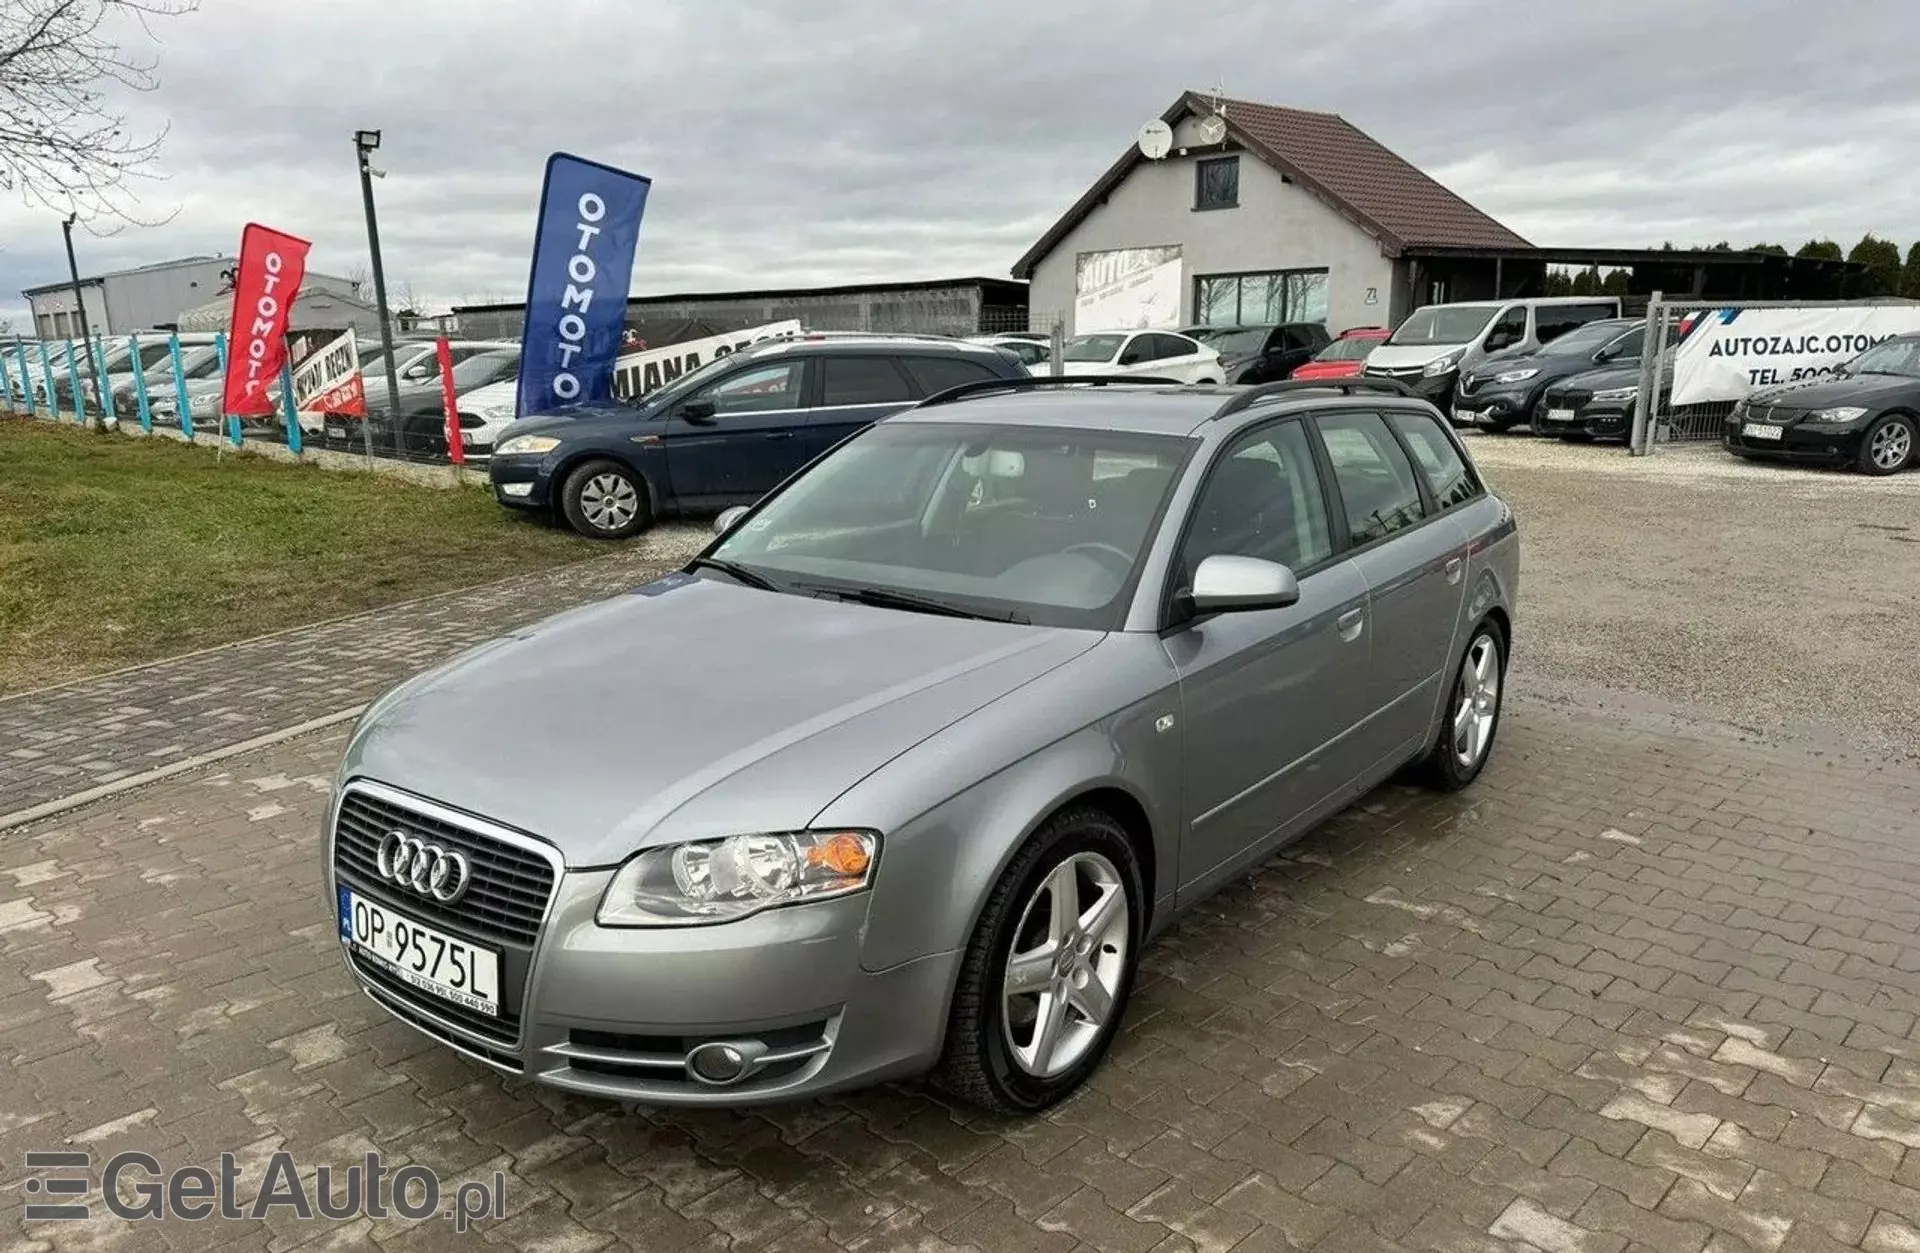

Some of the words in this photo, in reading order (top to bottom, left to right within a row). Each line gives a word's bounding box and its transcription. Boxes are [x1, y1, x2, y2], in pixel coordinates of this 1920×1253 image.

[553, 193, 606, 399] OTOMOTO
[1749, 368, 1785, 386] TEL.
[355, 901, 385, 948] OP
[395, 921, 488, 999] 9575L
